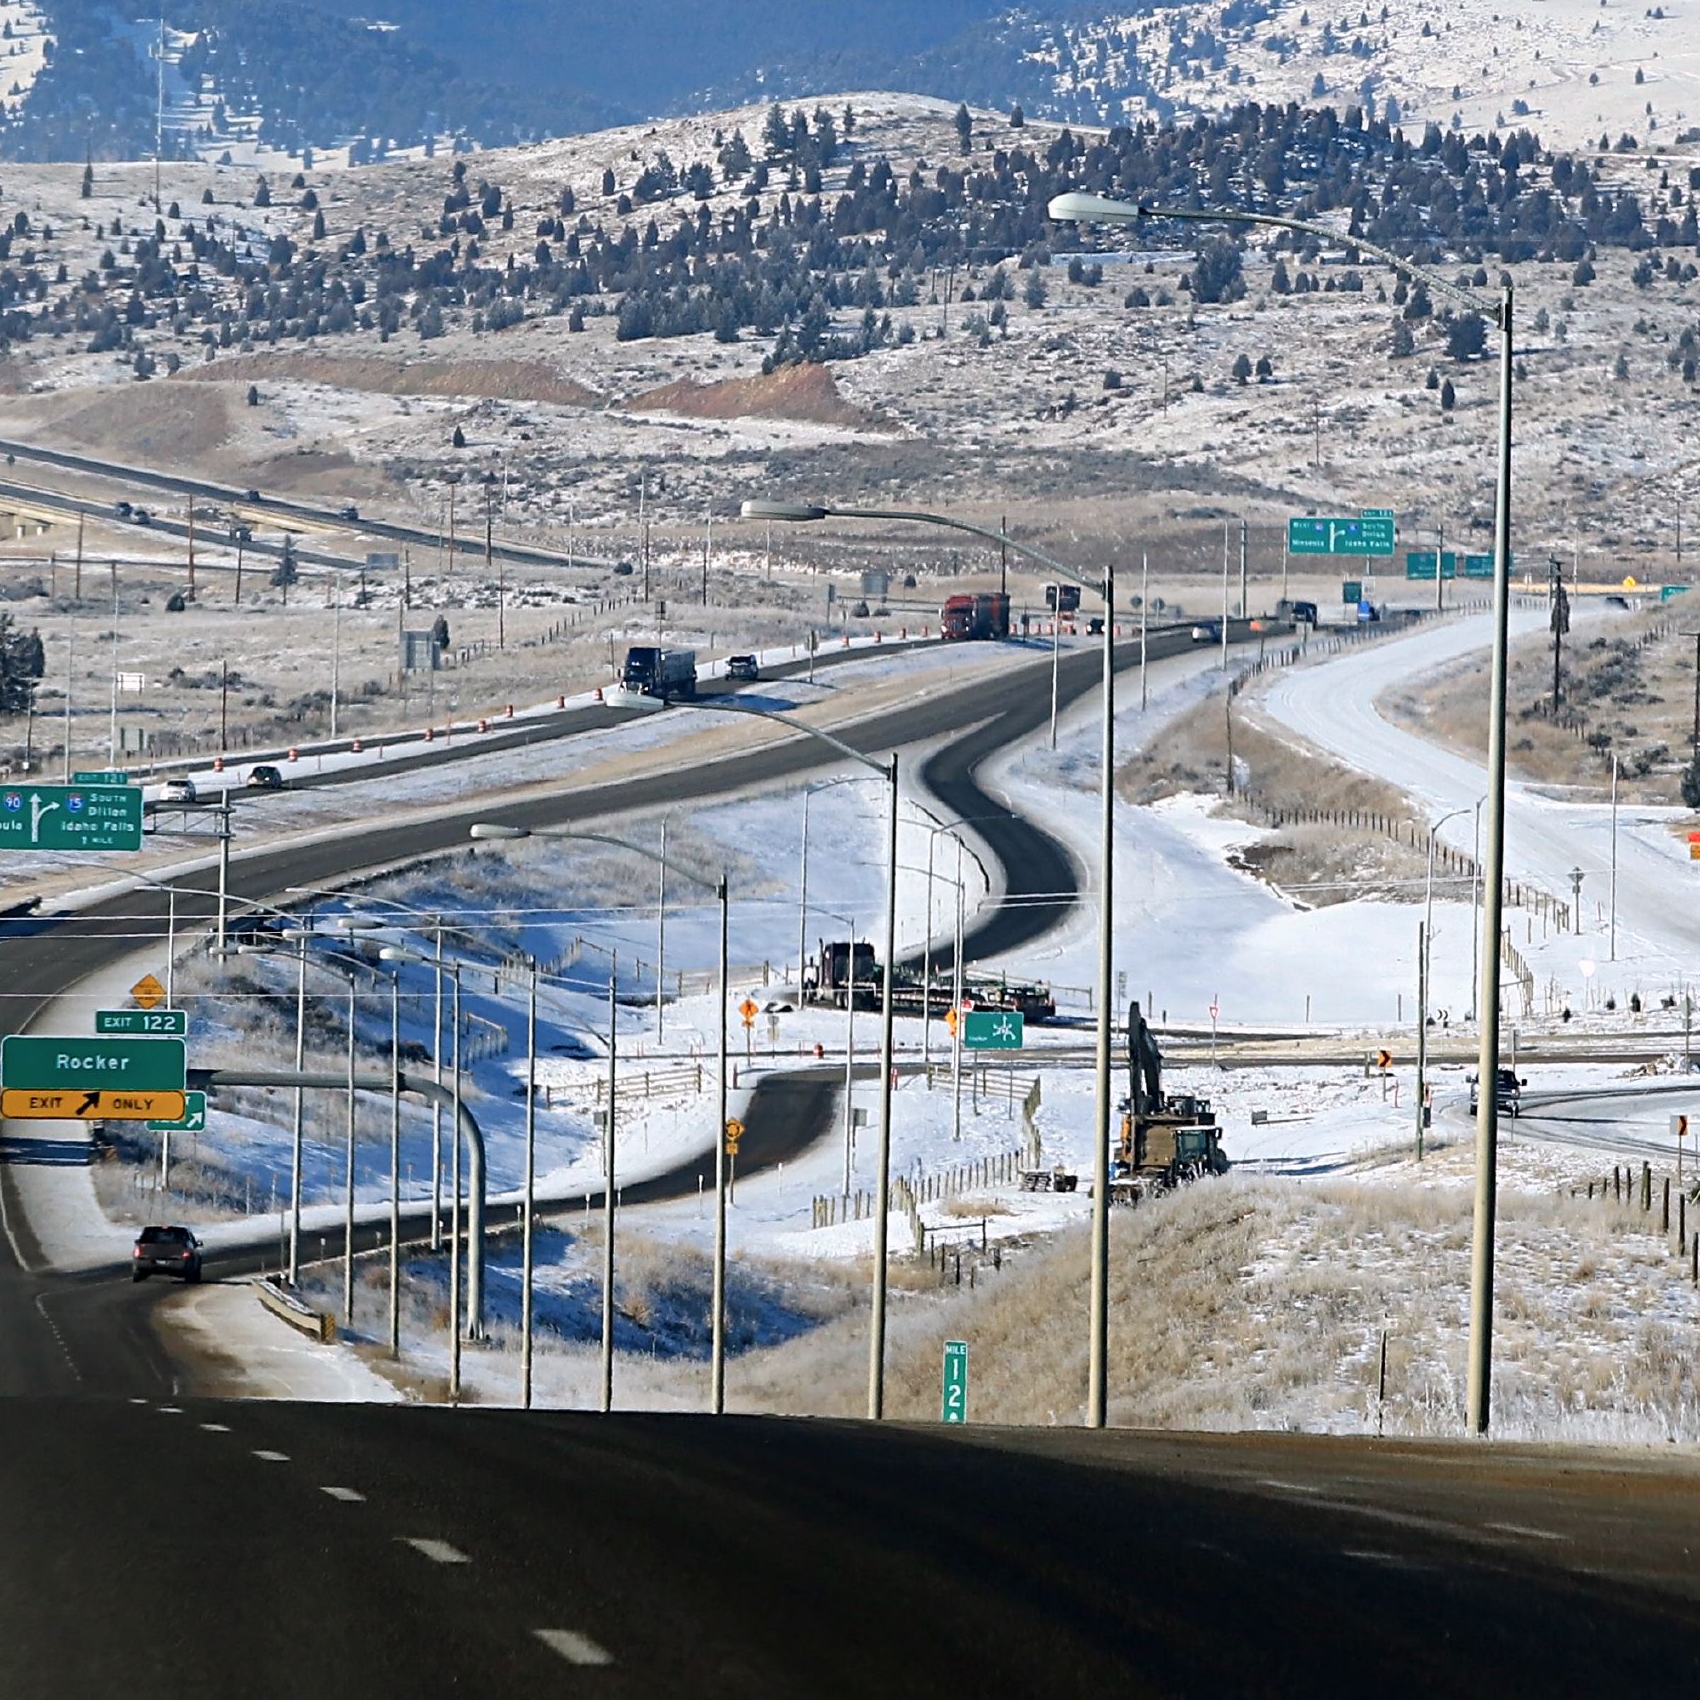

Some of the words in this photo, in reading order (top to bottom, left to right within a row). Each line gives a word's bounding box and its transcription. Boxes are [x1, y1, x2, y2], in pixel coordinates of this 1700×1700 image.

[104, 773, 123, 783] 121
[5, 797, 21, 809] 90
[69, 797, 82, 809] 15
[88, 807, 127, 817] Dillon
[61, 821, 98, 832] Idaho
[103, 821, 134, 832] Falls
[104, 1016, 132, 1028] EXIT
[142, 1015, 176, 1031] 122
[56, 1054, 130, 1071] Rocker
[29, 1096, 62, 1109] EXIT
[113, 1097, 154, 1110] ONLY
[945, 1345, 966, 1355] MILE
